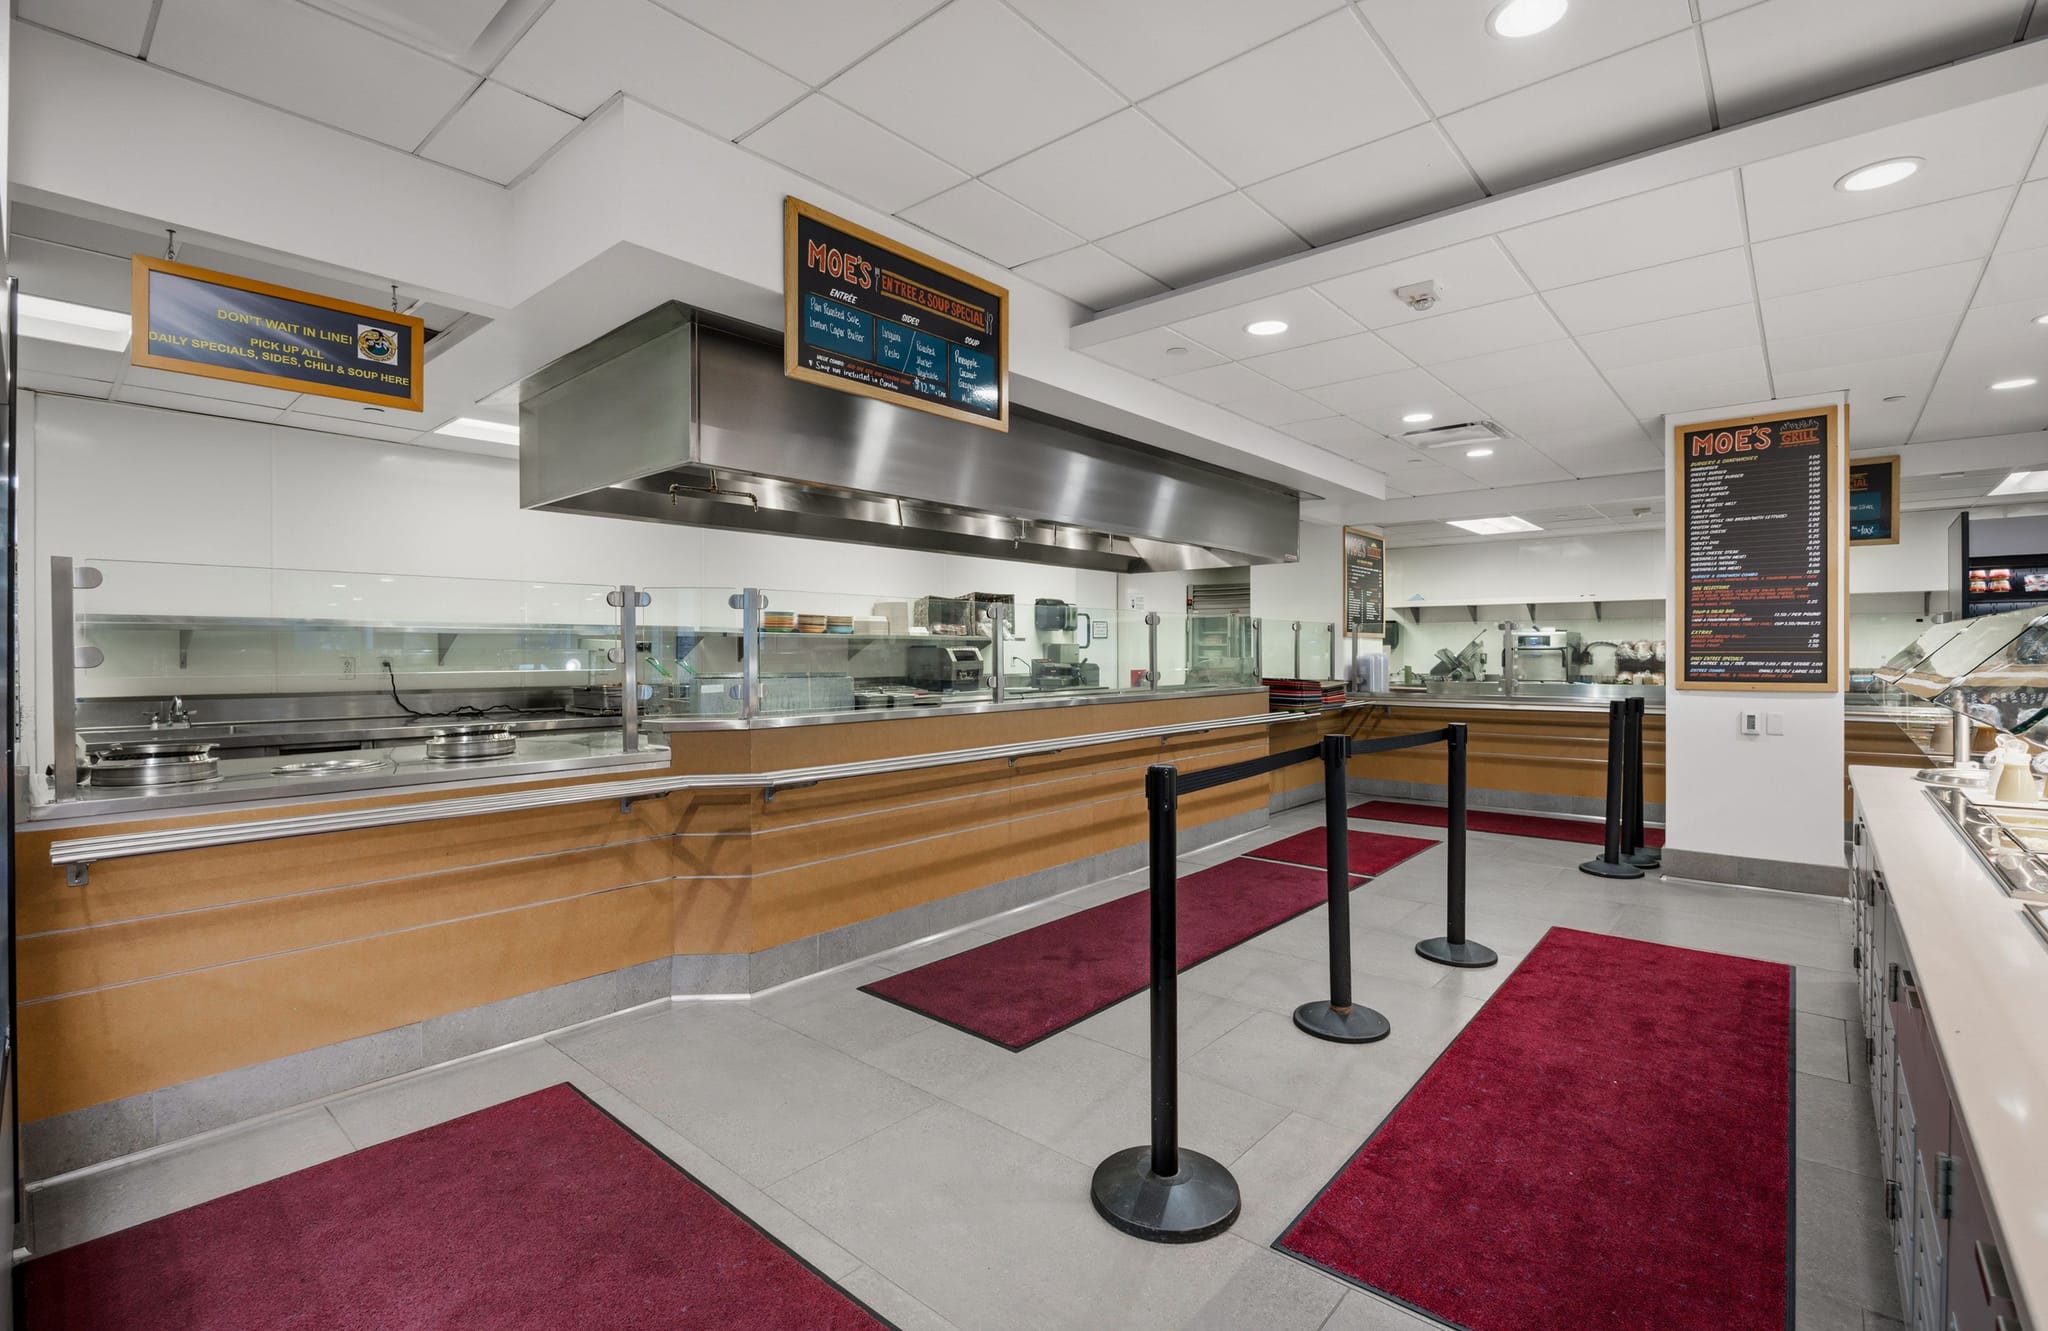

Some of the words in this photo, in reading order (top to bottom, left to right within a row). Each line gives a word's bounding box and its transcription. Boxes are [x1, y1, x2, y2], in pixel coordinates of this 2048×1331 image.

[808, 239, 872, 289] MOE'S
[810, 297, 822, 312] Pan
[882, 275, 918, 302] ENTREE
[919, 290, 926, 304] &
[928, 293, 950, 312] SOUP
[951, 303, 984, 326] SPECIAL
[217, 309, 262, 327] DON'T
[265, 319, 300, 334] WAIT
[303, 326, 316, 338] IN
[319, 330, 353, 346] LINE!
[810, 316, 828, 332] Lemon
[901, 314, 920, 326] SIDES
[250, 338, 279, 351] PICK
[282, 343, 299, 354] UP
[301, 348, 325, 360] ALL
[964, 336, 980, 347] SOUP
[149, 331, 188, 347] DAILY
[191, 339, 259, 360] SPECIALS,
[262, 352, 301, 368] SIDES,
[304, 360, 334, 374] CHILI
[336, 365, 345, 374] &
[347, 368, 378, 380] SOUP
[380, 373, 409, 386] HERE
[844, 370, 870, 382] included
[1692, 426, 1771, 456] MOE'S
